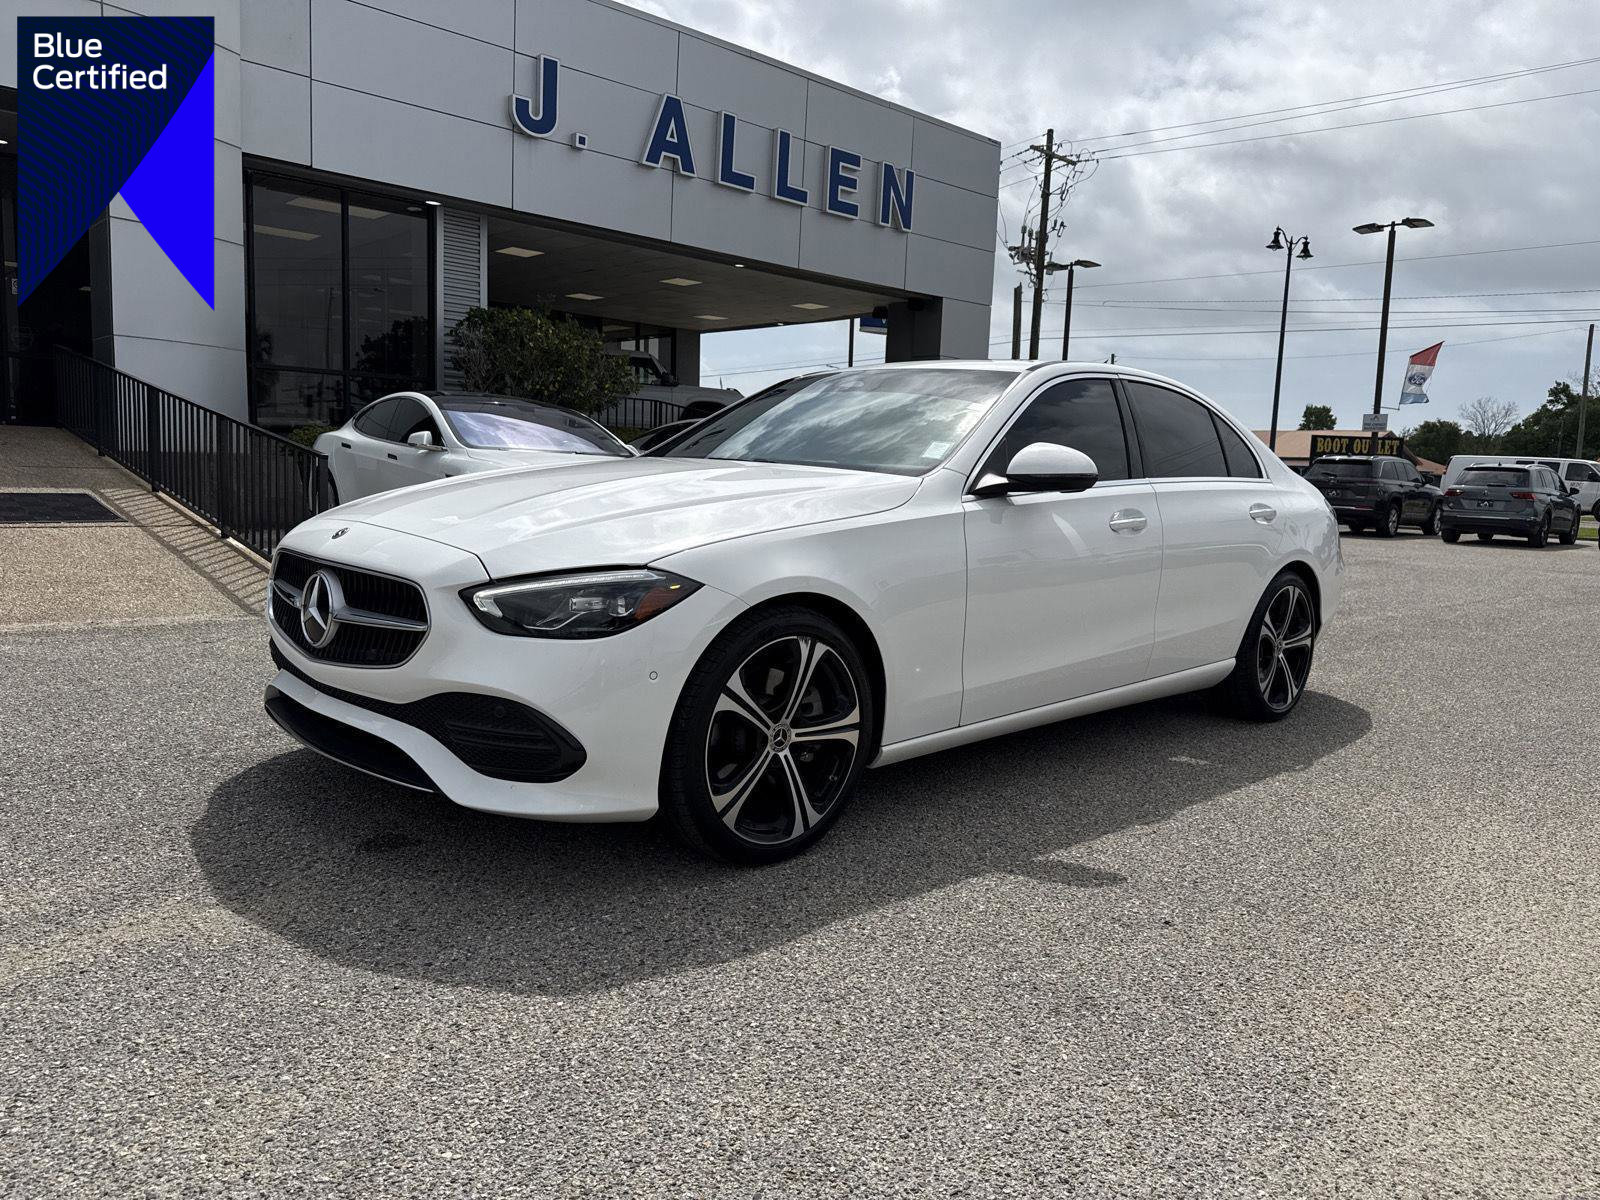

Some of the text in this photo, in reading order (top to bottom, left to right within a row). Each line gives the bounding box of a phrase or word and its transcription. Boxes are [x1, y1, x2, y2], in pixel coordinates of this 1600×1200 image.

[508, 54, 916, 232] J. ALLEN
[1316, 437, 1400, 455] BOOT OULET
